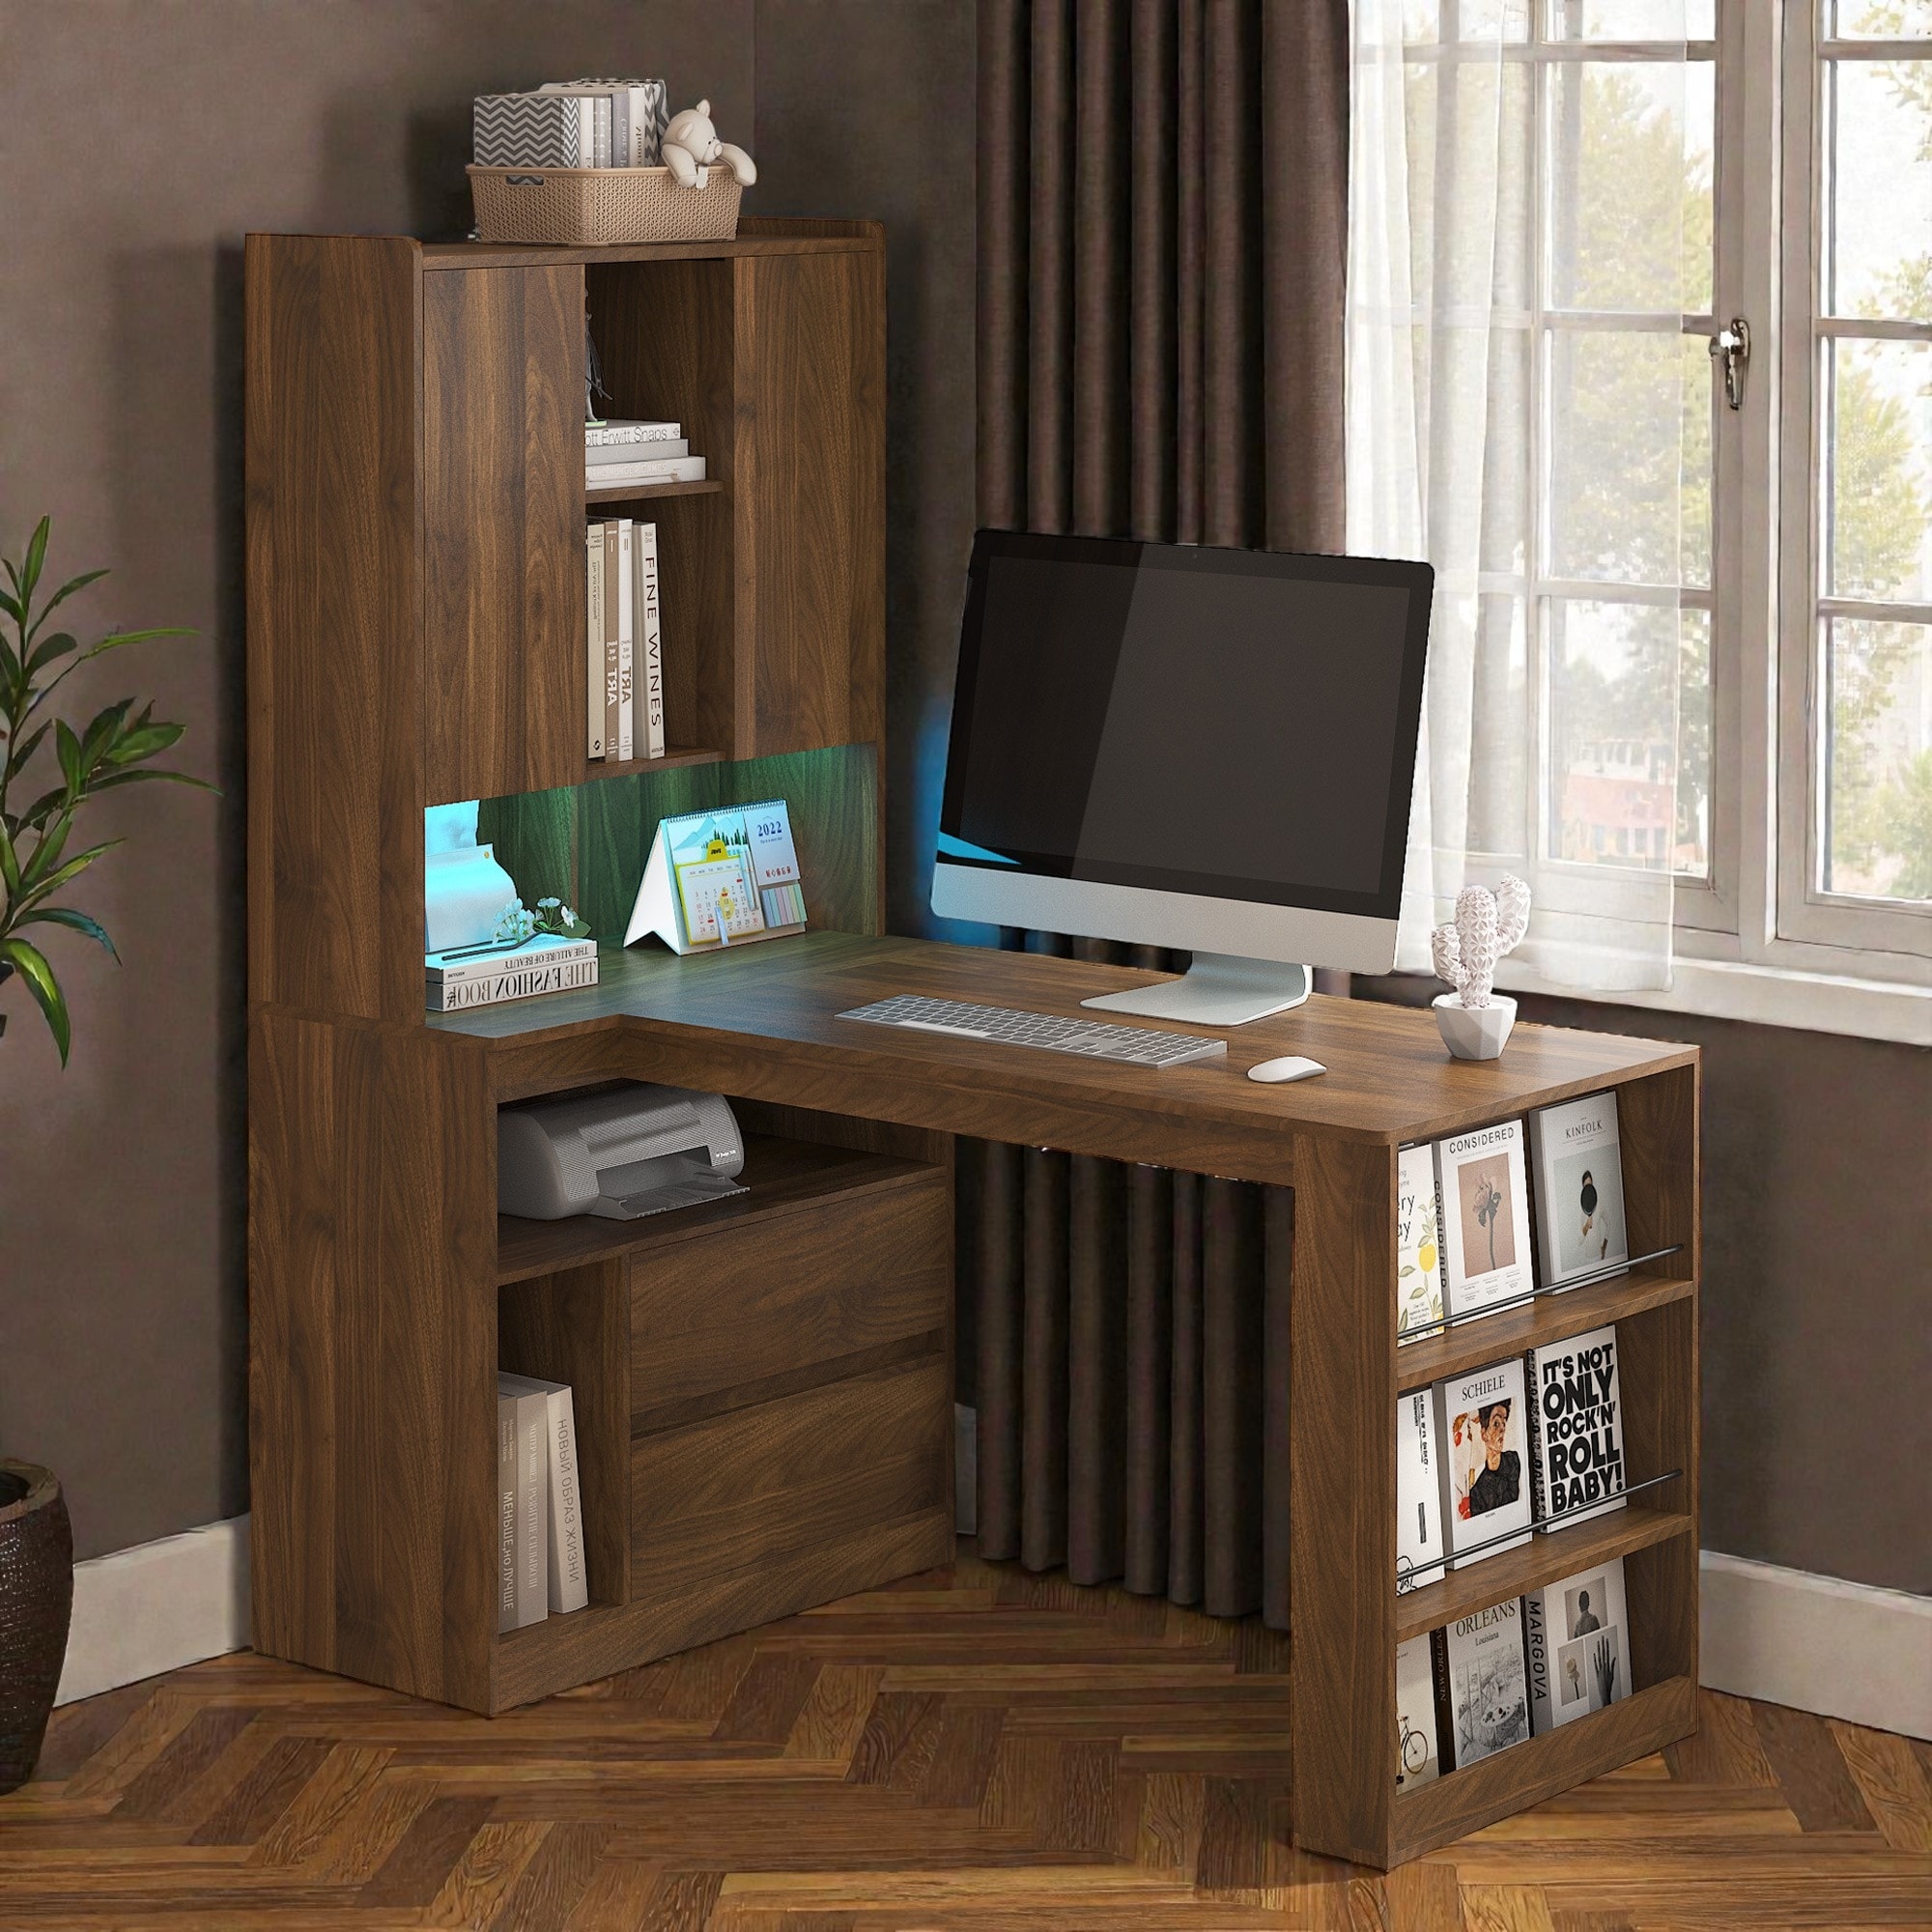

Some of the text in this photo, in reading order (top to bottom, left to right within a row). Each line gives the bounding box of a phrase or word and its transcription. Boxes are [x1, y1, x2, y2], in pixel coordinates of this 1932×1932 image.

[602, 429, 631, 445] Erwitt
[634, 426, 668, 442] Snaps
[645, 556, 658, 620] FINE
[648, 632, 662, 726] WINES
[757, 820, 782, 838] 2022
[504, 946, 588, 970] THE ALLURE OF BEAUTY
[1449, 1126, 1515, 1154] CONSIDERED
[1565, 1119, 1604, 1139] KINFOLK
[1434, 1180, 1447, 1289] CONSIDERED
[1544, 1343, 1614, 1385] IT'S NOT
[1462, 1375, 1505, 1402] SCHIELE
[1543, 1365, 1614, 1420] ONLY
[1548, 1427, 1620, 1483] ROLL
[557, 1418, 580, 1584] НОВЫЙ ОБРАЗ ЖИЗНИ
[1550, 1462, 1623, 1514] BABY!
[502, 1567, 514, 1611] ЛУЧШЕ
[1456, 1600, 1517, 1637] ORLEANS
[1475, 1632, 1499, 1647] Louisiana
[1528, 1600, 1547, 1700] MARGOVA
